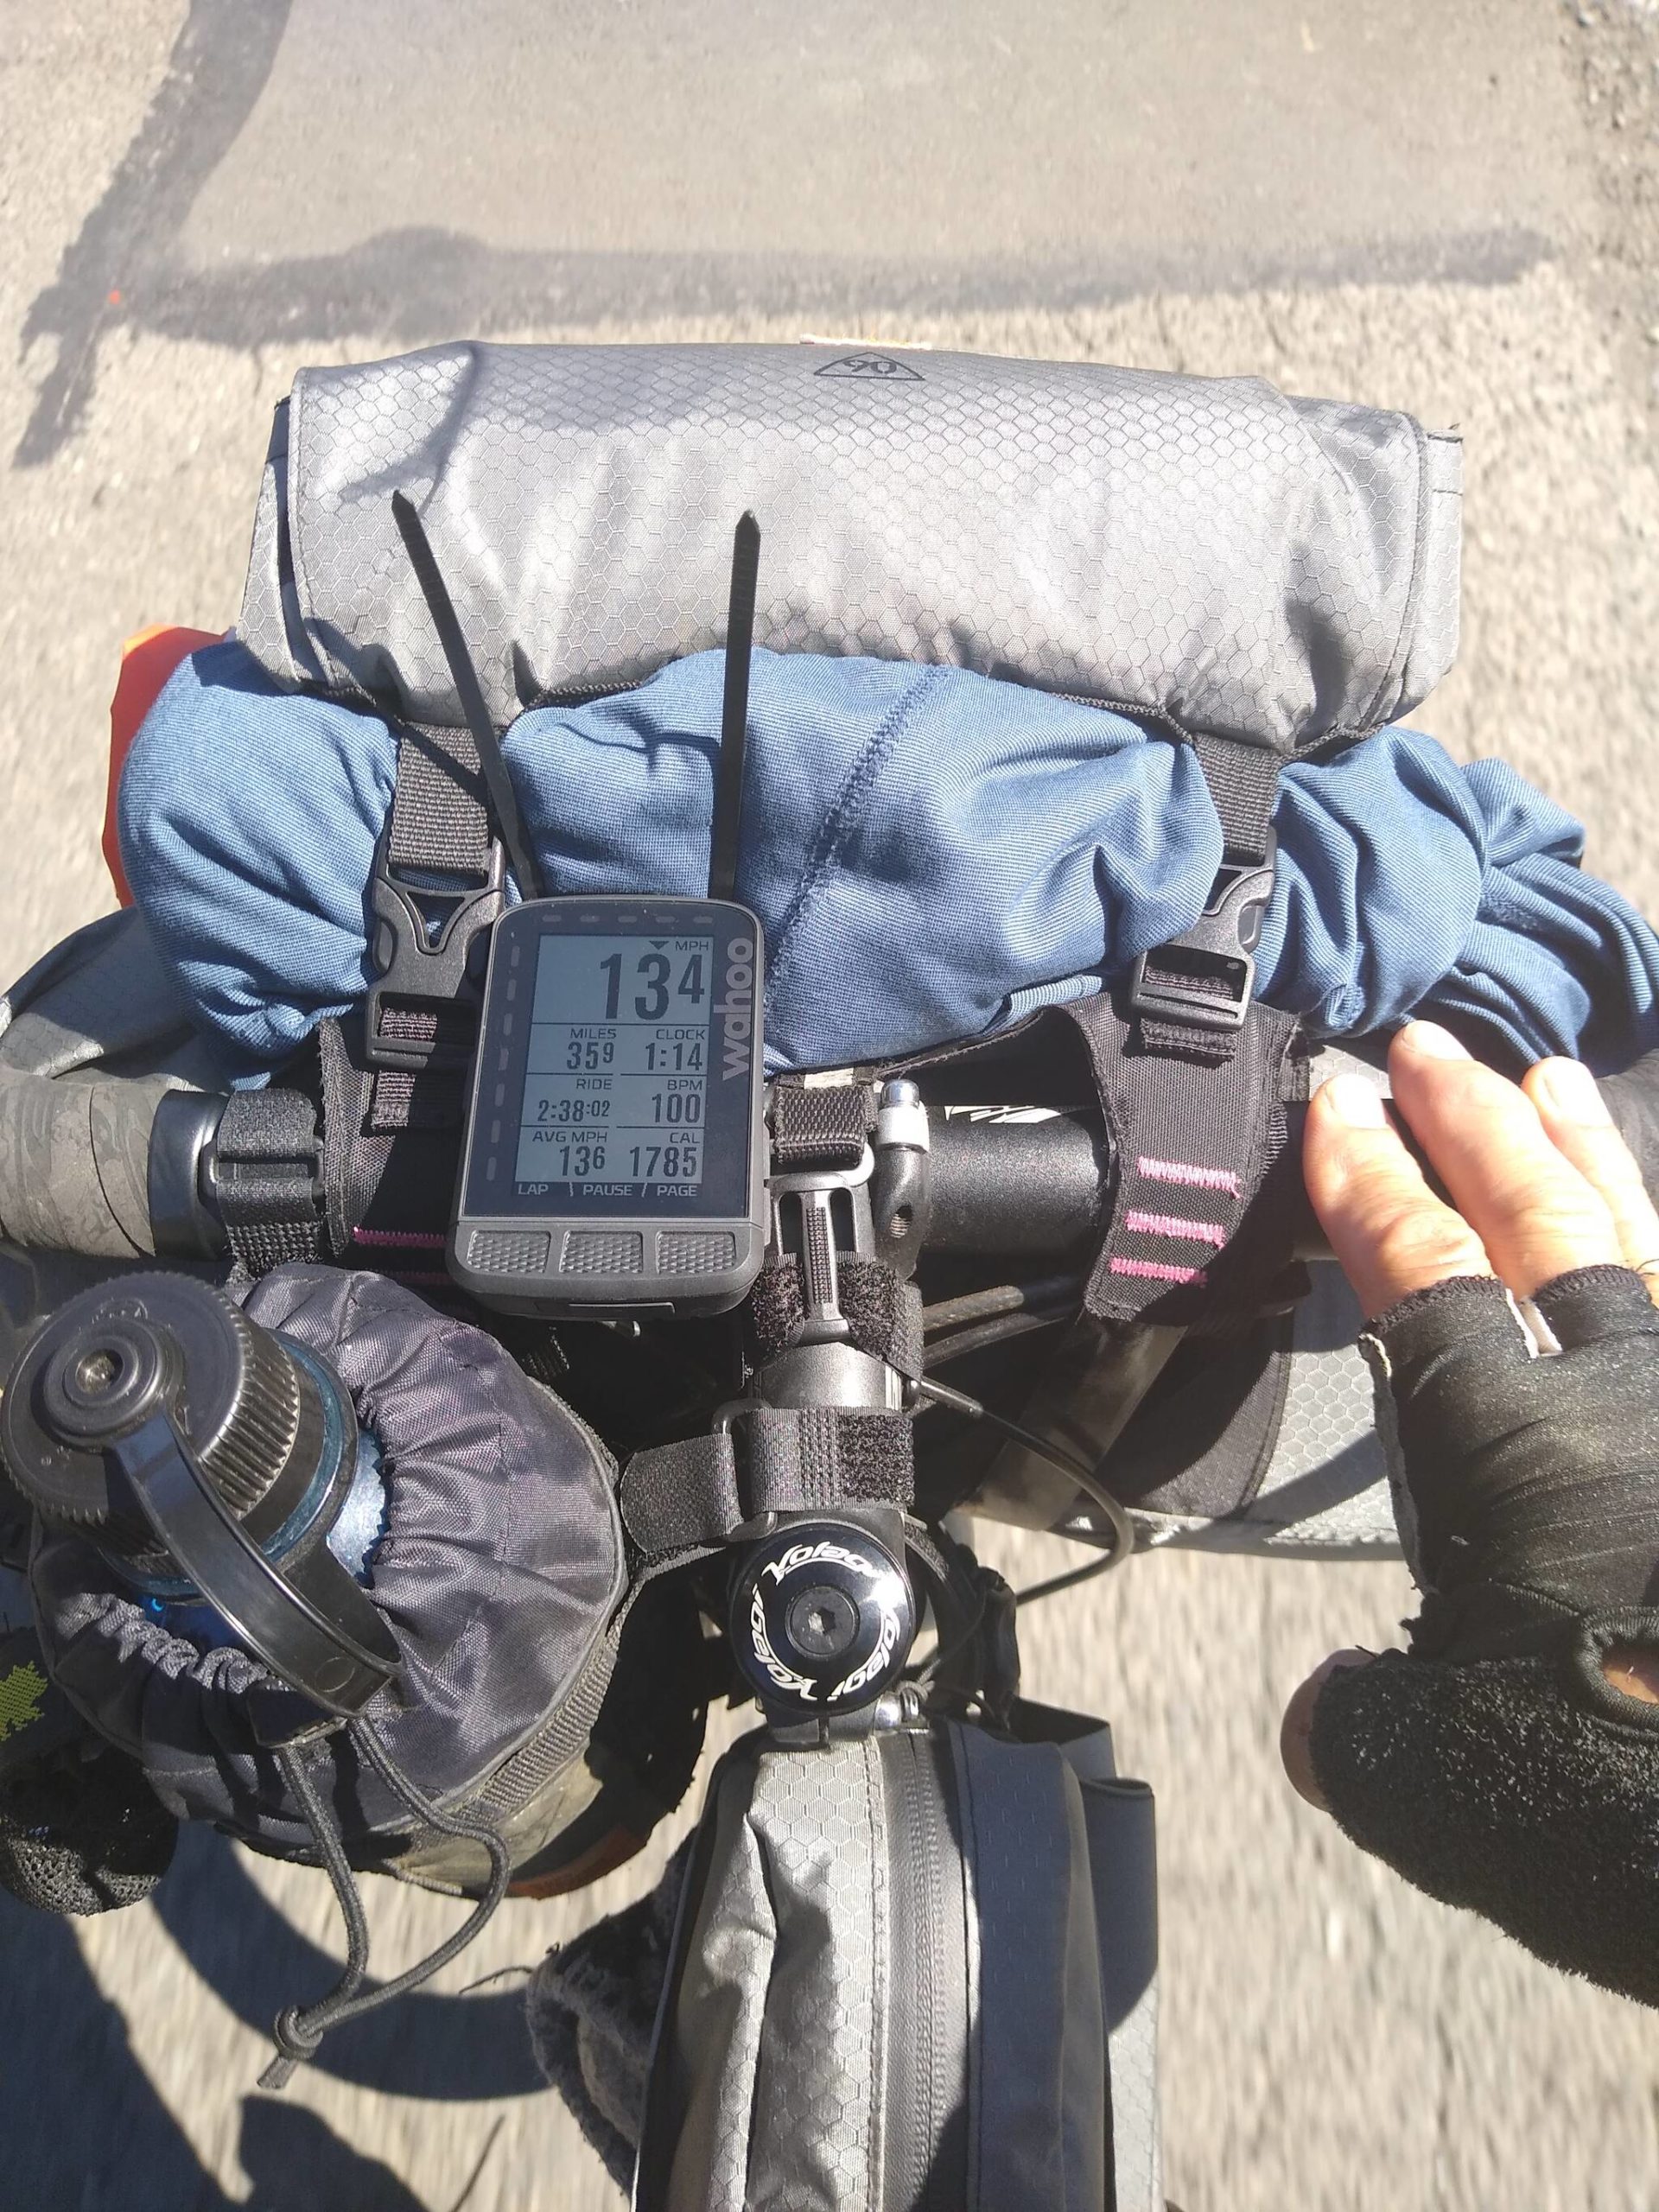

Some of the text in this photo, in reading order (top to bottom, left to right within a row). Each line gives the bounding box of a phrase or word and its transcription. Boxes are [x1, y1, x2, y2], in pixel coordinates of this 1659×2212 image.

[676, 940, 709, 951] MPH
[713, 938, 753, 1081] wahoo
[570, 1027, 617, 1039] MILES
[656, 1029, 706, 1040] CLOCK
[645, 1043, 702, 1071] 1:14
[576, 1078, 613, 1090] RIDE
[667, 1079, 703, 1090] BPM
[538, 1099, 611, 1122] 2:38:02
[652, 1094, 702, 1123] 100
[532, 1131, 607, 1143] AVG MPH
[670, 1132, 700, 1144] CAL
[629, 1147, 697, 1178] 1785
[518, 1184, 697, 1197] LAP PAUSE PAGE
